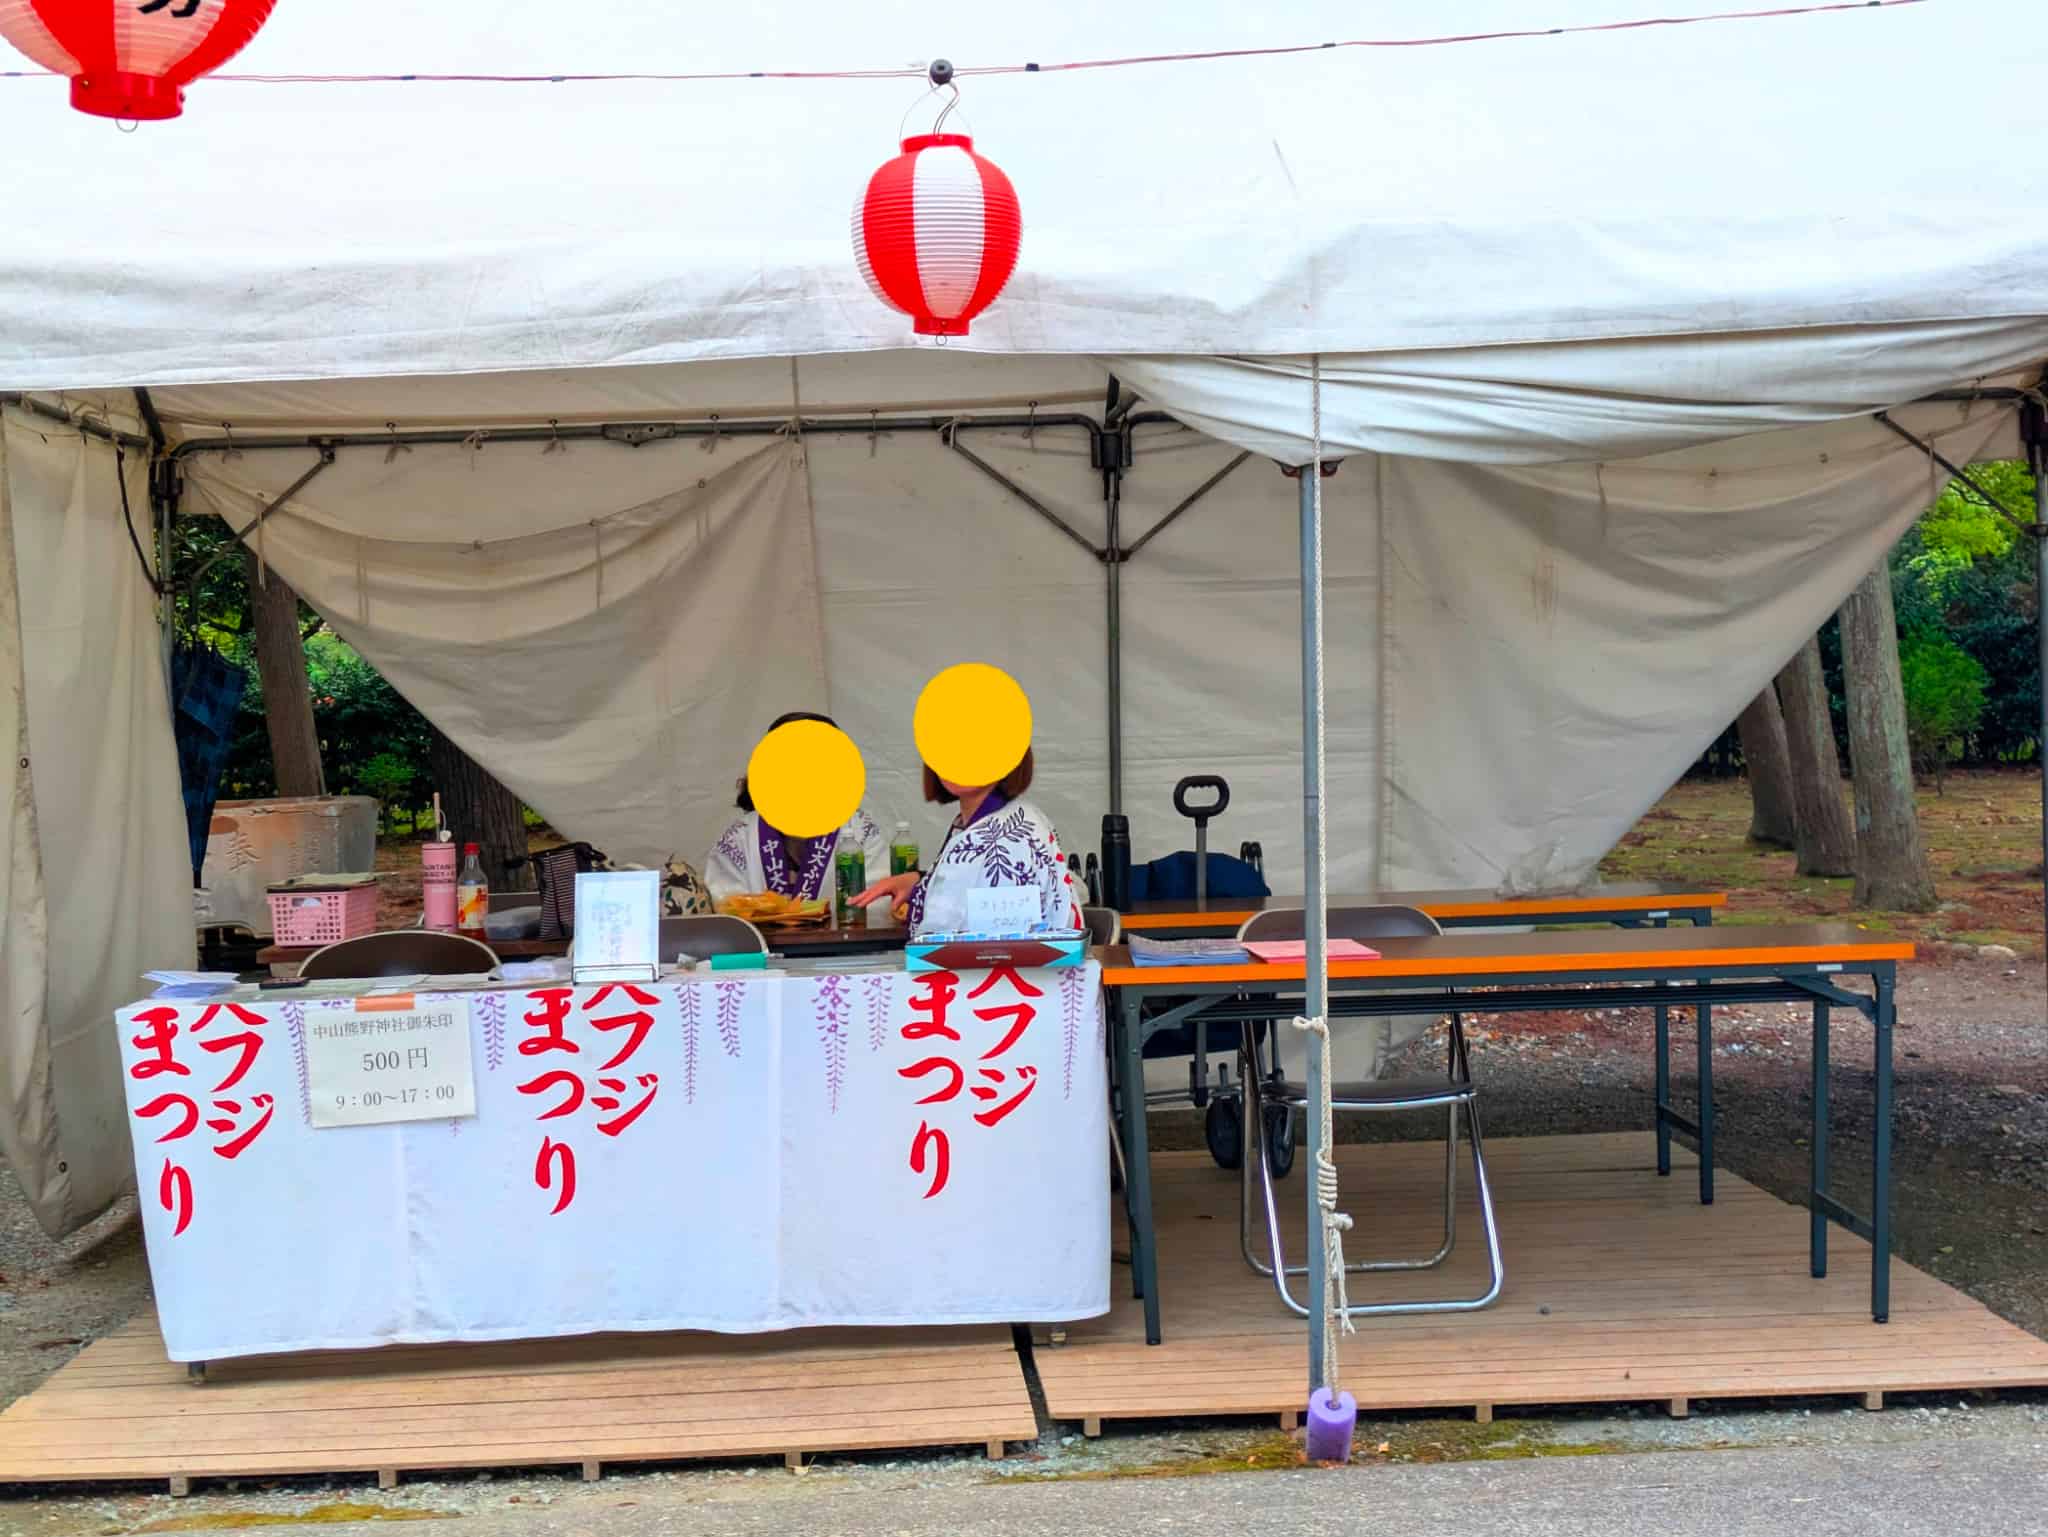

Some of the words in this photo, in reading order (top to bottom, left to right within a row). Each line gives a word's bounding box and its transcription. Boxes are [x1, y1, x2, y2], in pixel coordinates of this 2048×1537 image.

[130, 1006, 199, 1237] まつり
[313, 1013, 453, 1039] 中山熊野神社御朱印
[362, 1051, 400, 1072] 500
[517, 988, 585, 1214] まつり
[898, 972, 964, 1198] まつり
